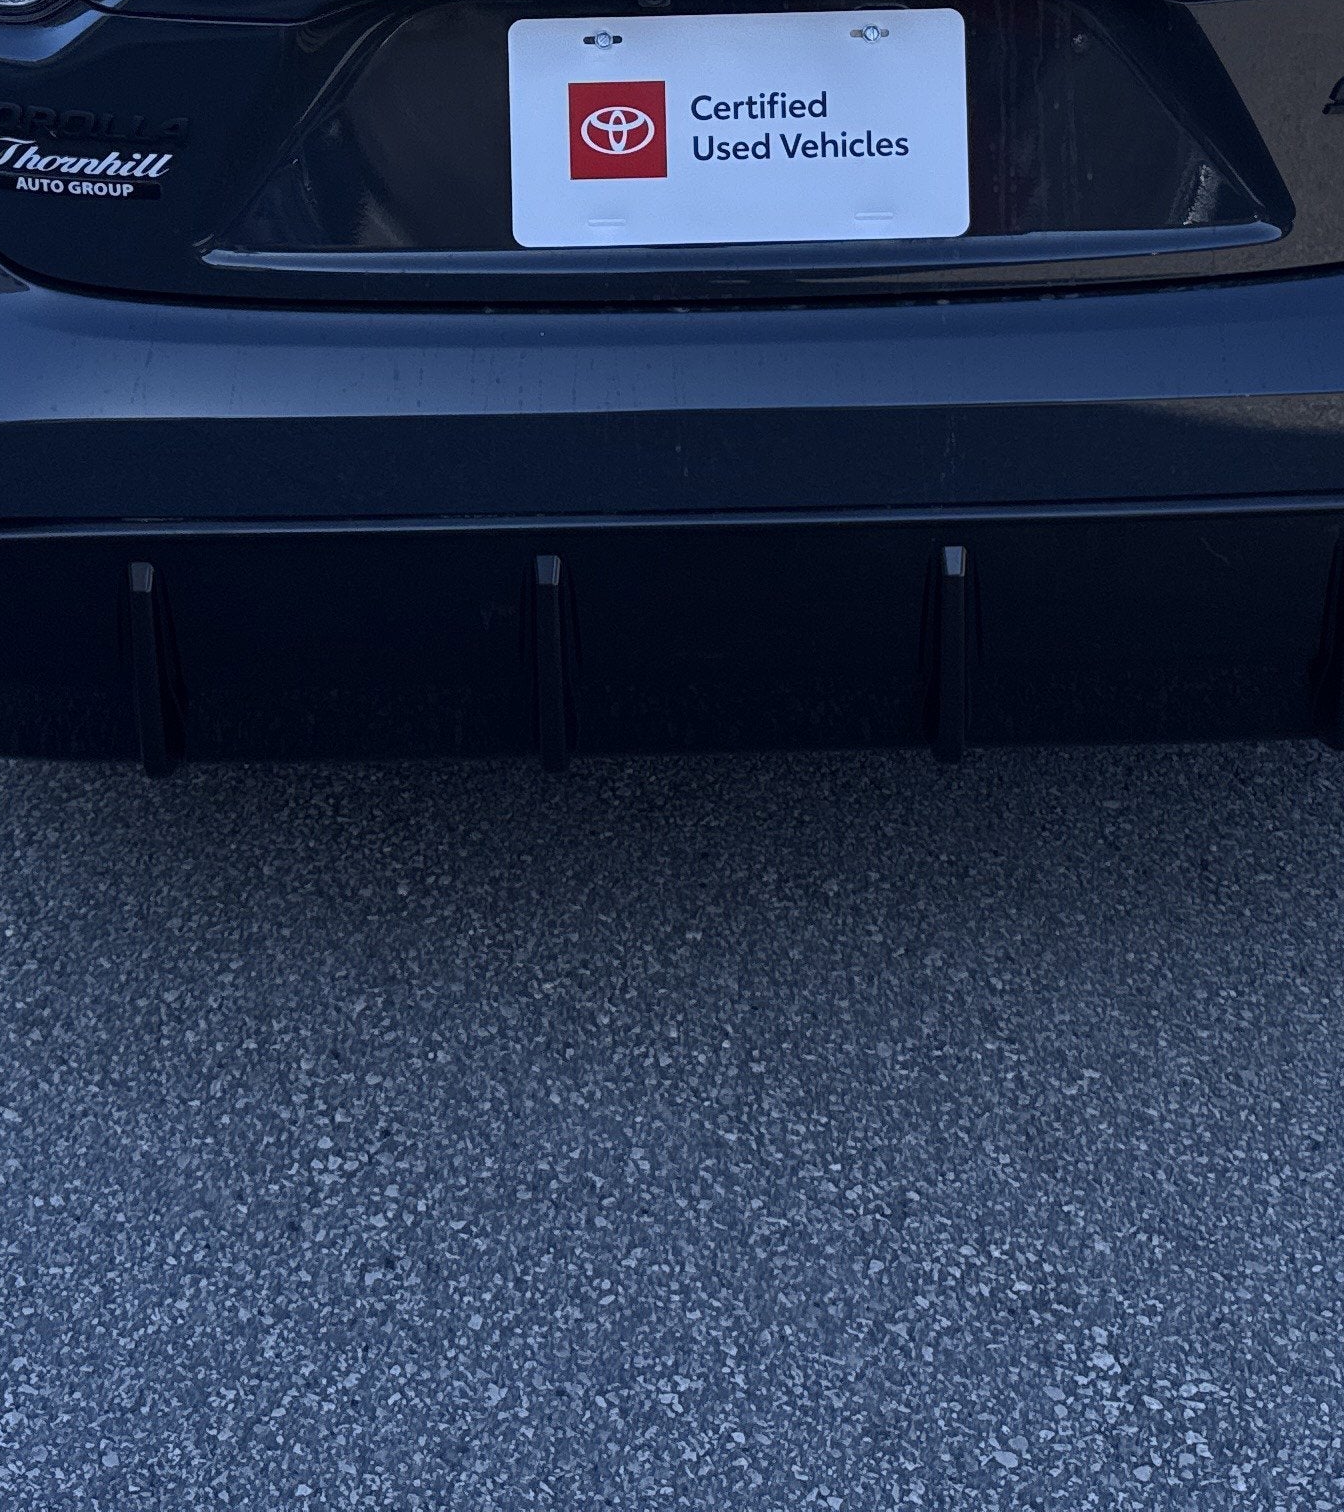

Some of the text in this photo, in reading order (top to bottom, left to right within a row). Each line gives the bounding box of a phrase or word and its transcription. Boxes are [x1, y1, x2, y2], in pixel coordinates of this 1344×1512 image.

[691, 91, 828, 121] Certified
[693, 131, 910, 161] Used Vehicles
[16, 176, 134, 197] AUTO GROUP
